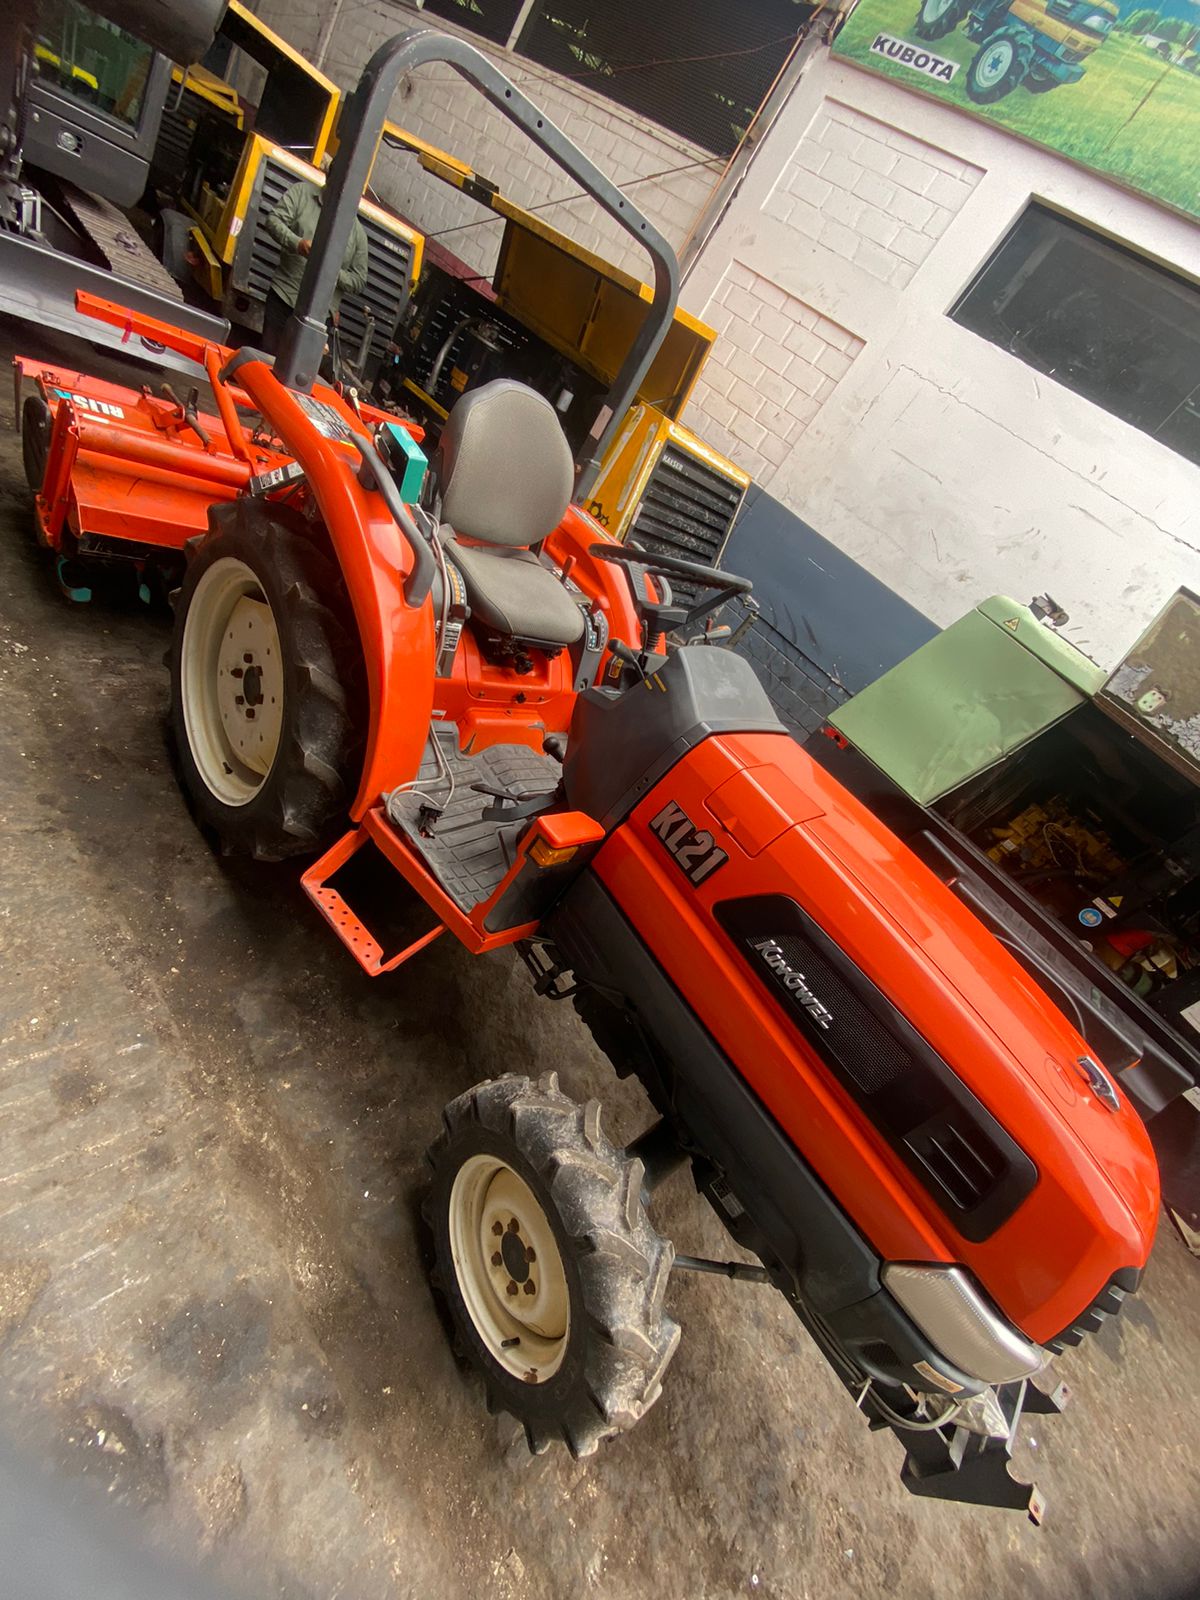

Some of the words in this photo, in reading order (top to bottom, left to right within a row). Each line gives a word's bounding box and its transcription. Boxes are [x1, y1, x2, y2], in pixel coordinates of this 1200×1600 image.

[872, 35, 954, 81] KUBOTA
[649, 800, 729, 887] KL21
[754, 939, 833, 1029] KINGWEL
